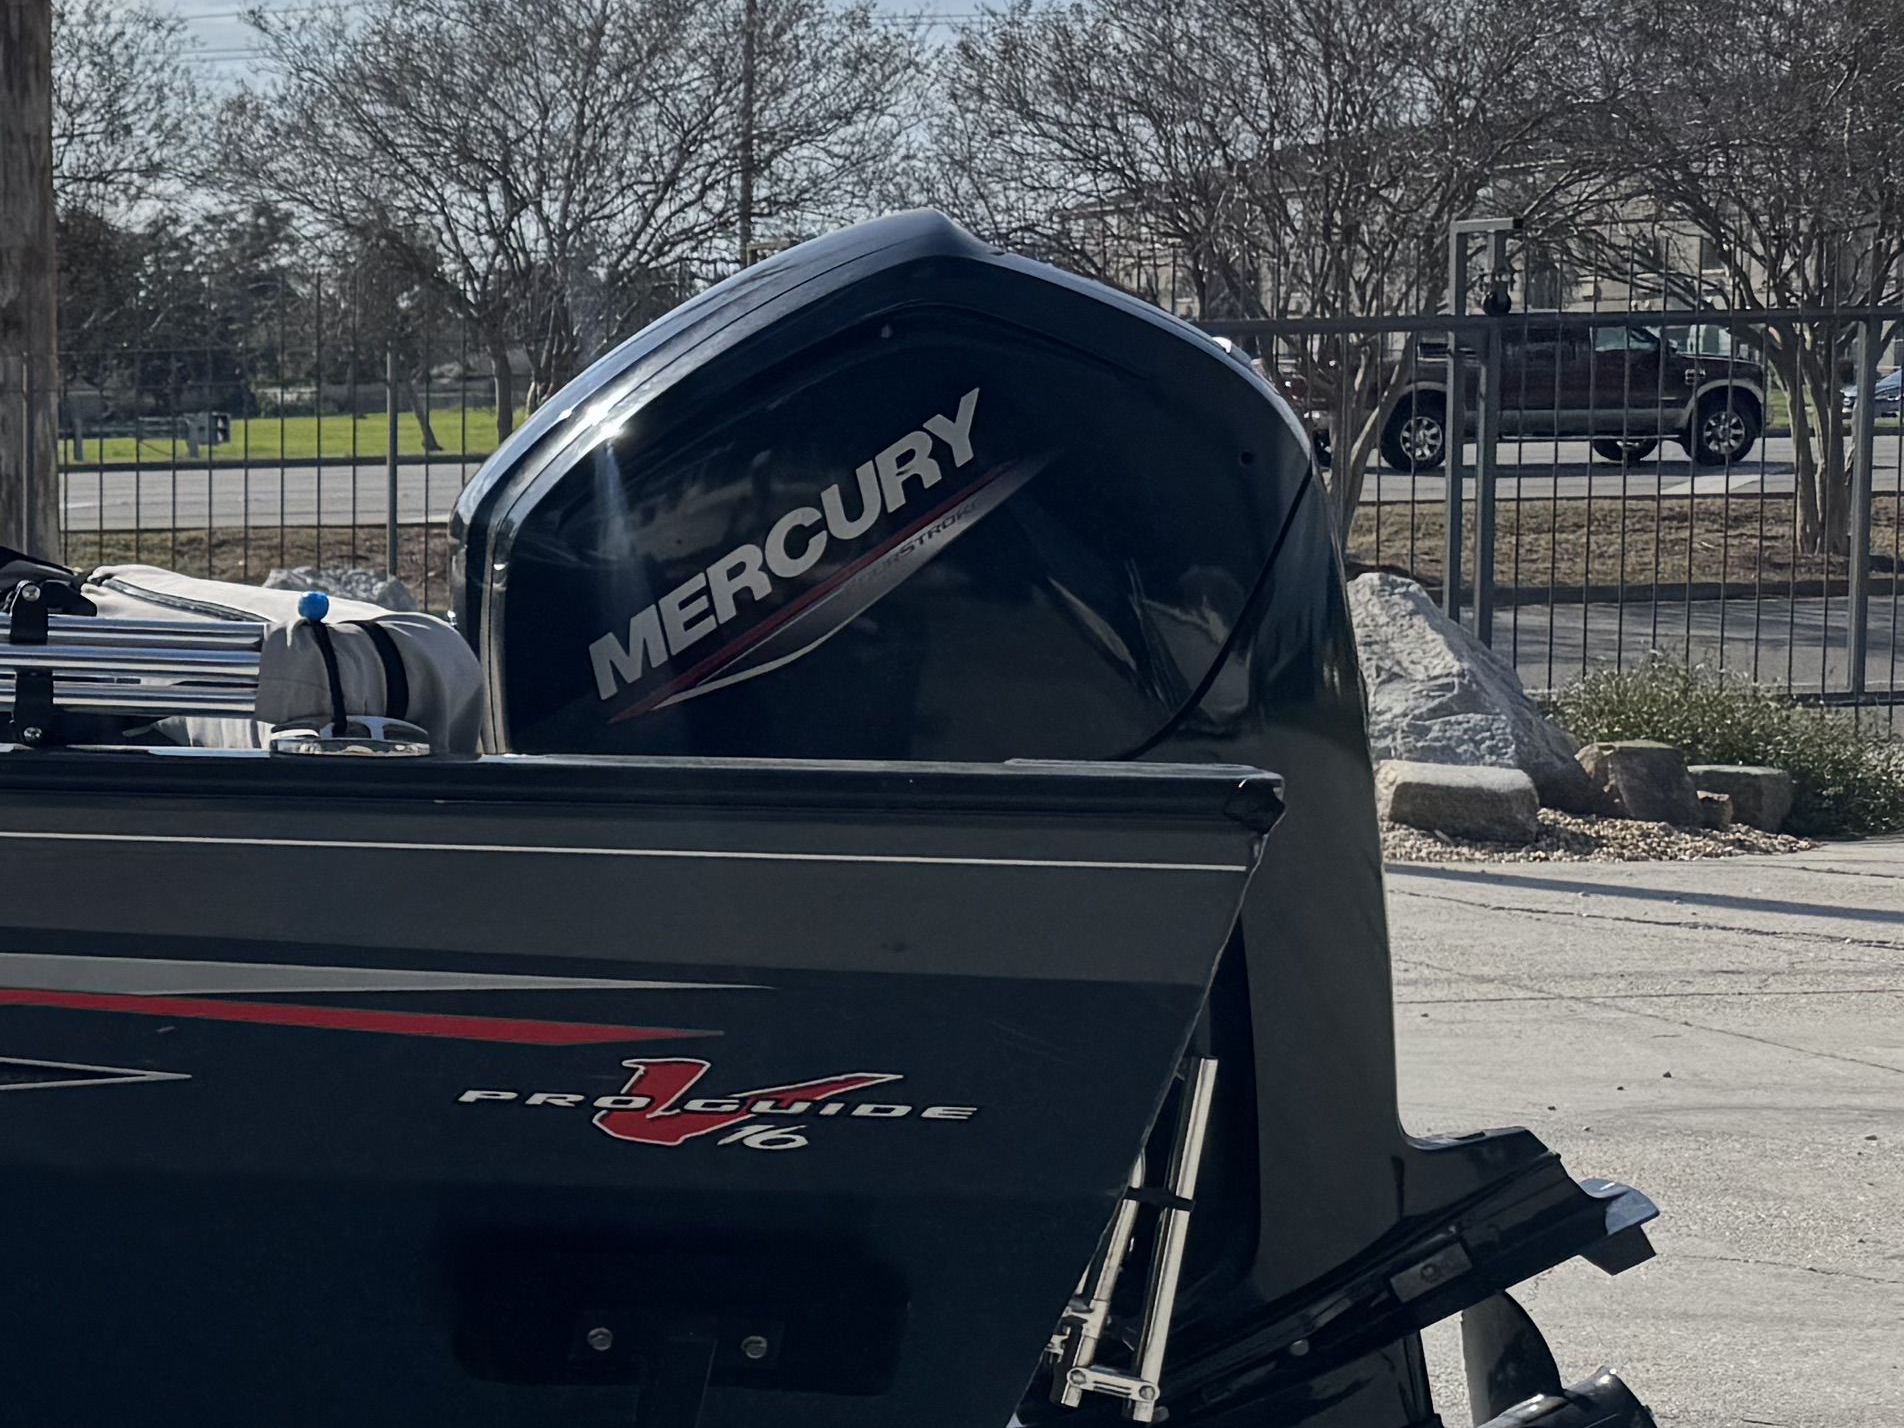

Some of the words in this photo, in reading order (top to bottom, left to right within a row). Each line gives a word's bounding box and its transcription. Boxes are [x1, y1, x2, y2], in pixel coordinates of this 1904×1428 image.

[588, 387, 980, 700] MERCURY
[458, 1089, 650, 1110] PRO
[684, 1097, 978, 1121] GUIDE
[716, 1123, 809, 1151] 16
